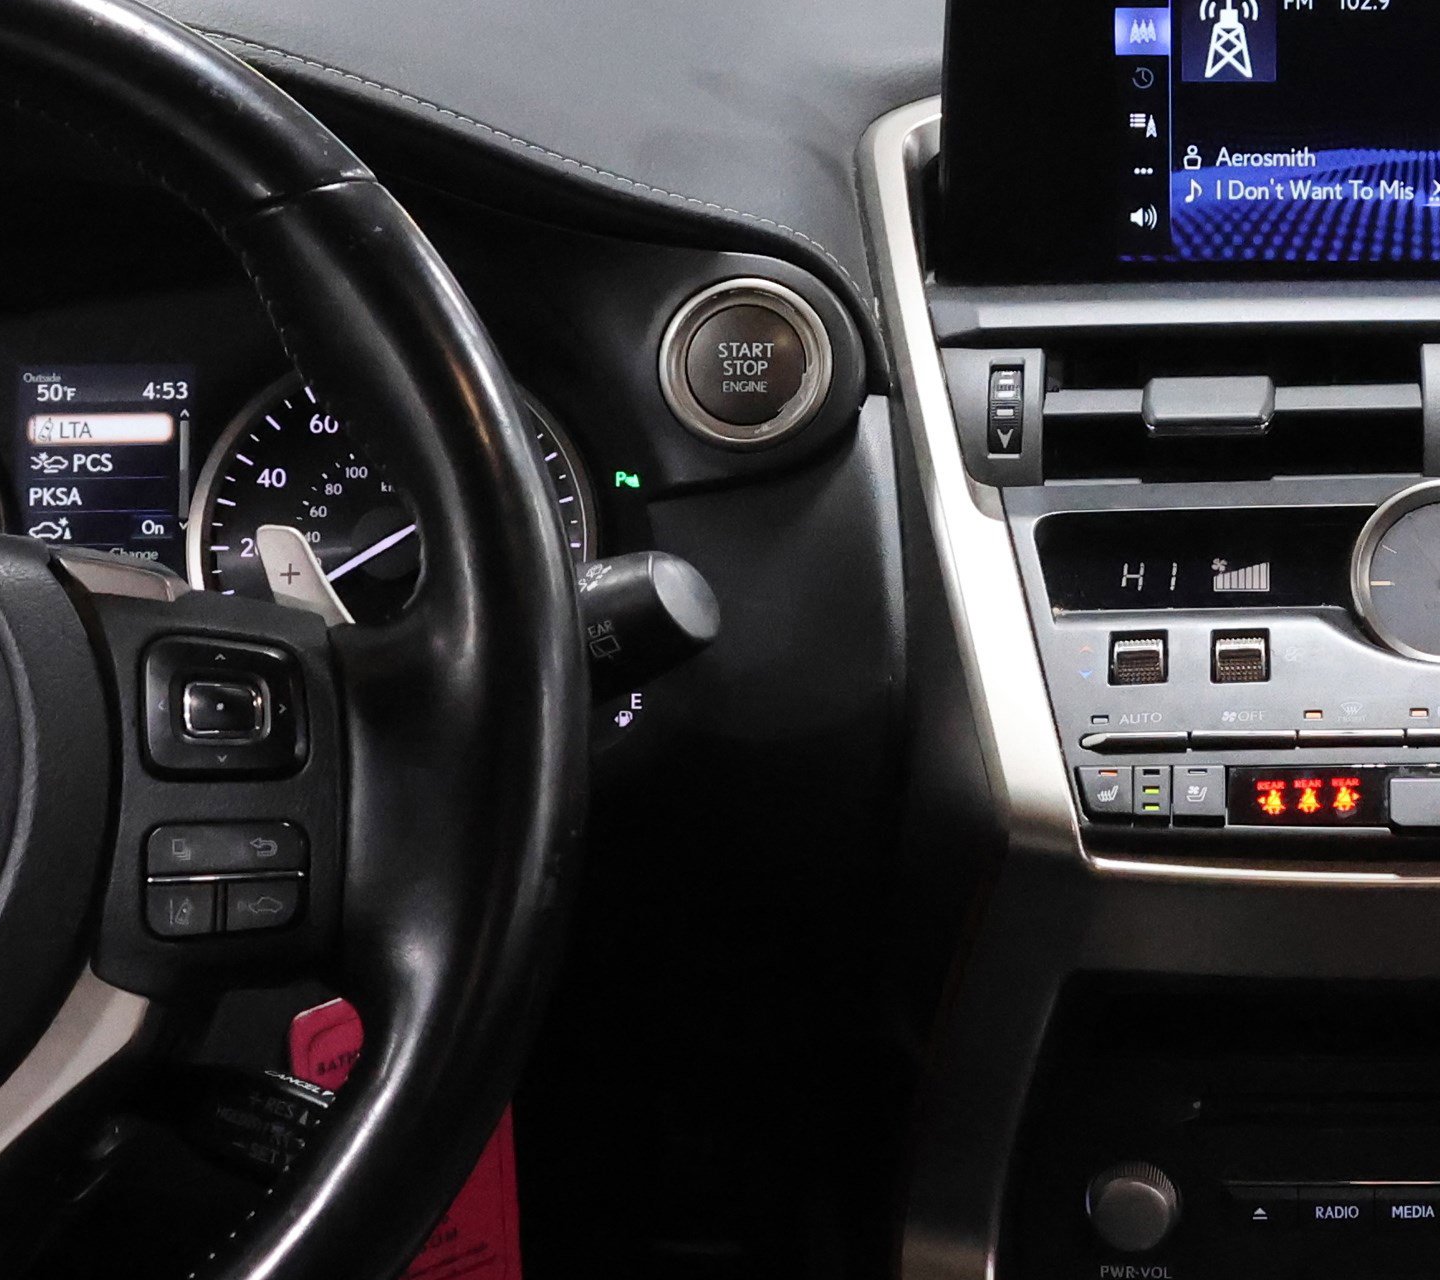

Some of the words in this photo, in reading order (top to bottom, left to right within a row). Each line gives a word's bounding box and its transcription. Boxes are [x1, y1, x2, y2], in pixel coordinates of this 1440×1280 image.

[1215, 147, 1316, 169] Aerosmith
[1215, 180, 1222, 202] I
[1228, 179, 1282, 202] Don't
[1287, 180, 1343, 202] Want
[1348, 180, 1372, 202] To
[1377, 179, 1415, 202] Mis
[718, 343, 774, 361] START
[723, 360, 768, 375] STOP
[143, 382, 188, 399] 4:53
[723, 381, 768, 392] ENGINE
[59, 421, 91, 439] LTA
[310, 414, 338, 433] 60
[73, 454, 112, 472] PCS
[257, 468, 286, 487] 40
[346, 467, 367, 478] 100
[30, 487, 82, 506] PKSA
[325, 484, 342, 495] 80
[308, 503, 327, 517] 60
[142, 520, 164, 534] On
[240, 538, 259, 558] 2
[587, 620, 613, 637] EAR
[631, 693, 642, 709] E
[1118, 712, 1163, 726] AUTO
[1238, 710, 1267, 722] OFF
[1256, 780, 1285, 790] REAR
[1294, 779, 1321, 788] REAR
[1331, 777, 1359, 787] REAR
[264, 1070, 321, 1093] CANCEL
[1316, 1206, 1359, 1218] RADIO
[1392, 1206, 1434, 1218] MEDIA
